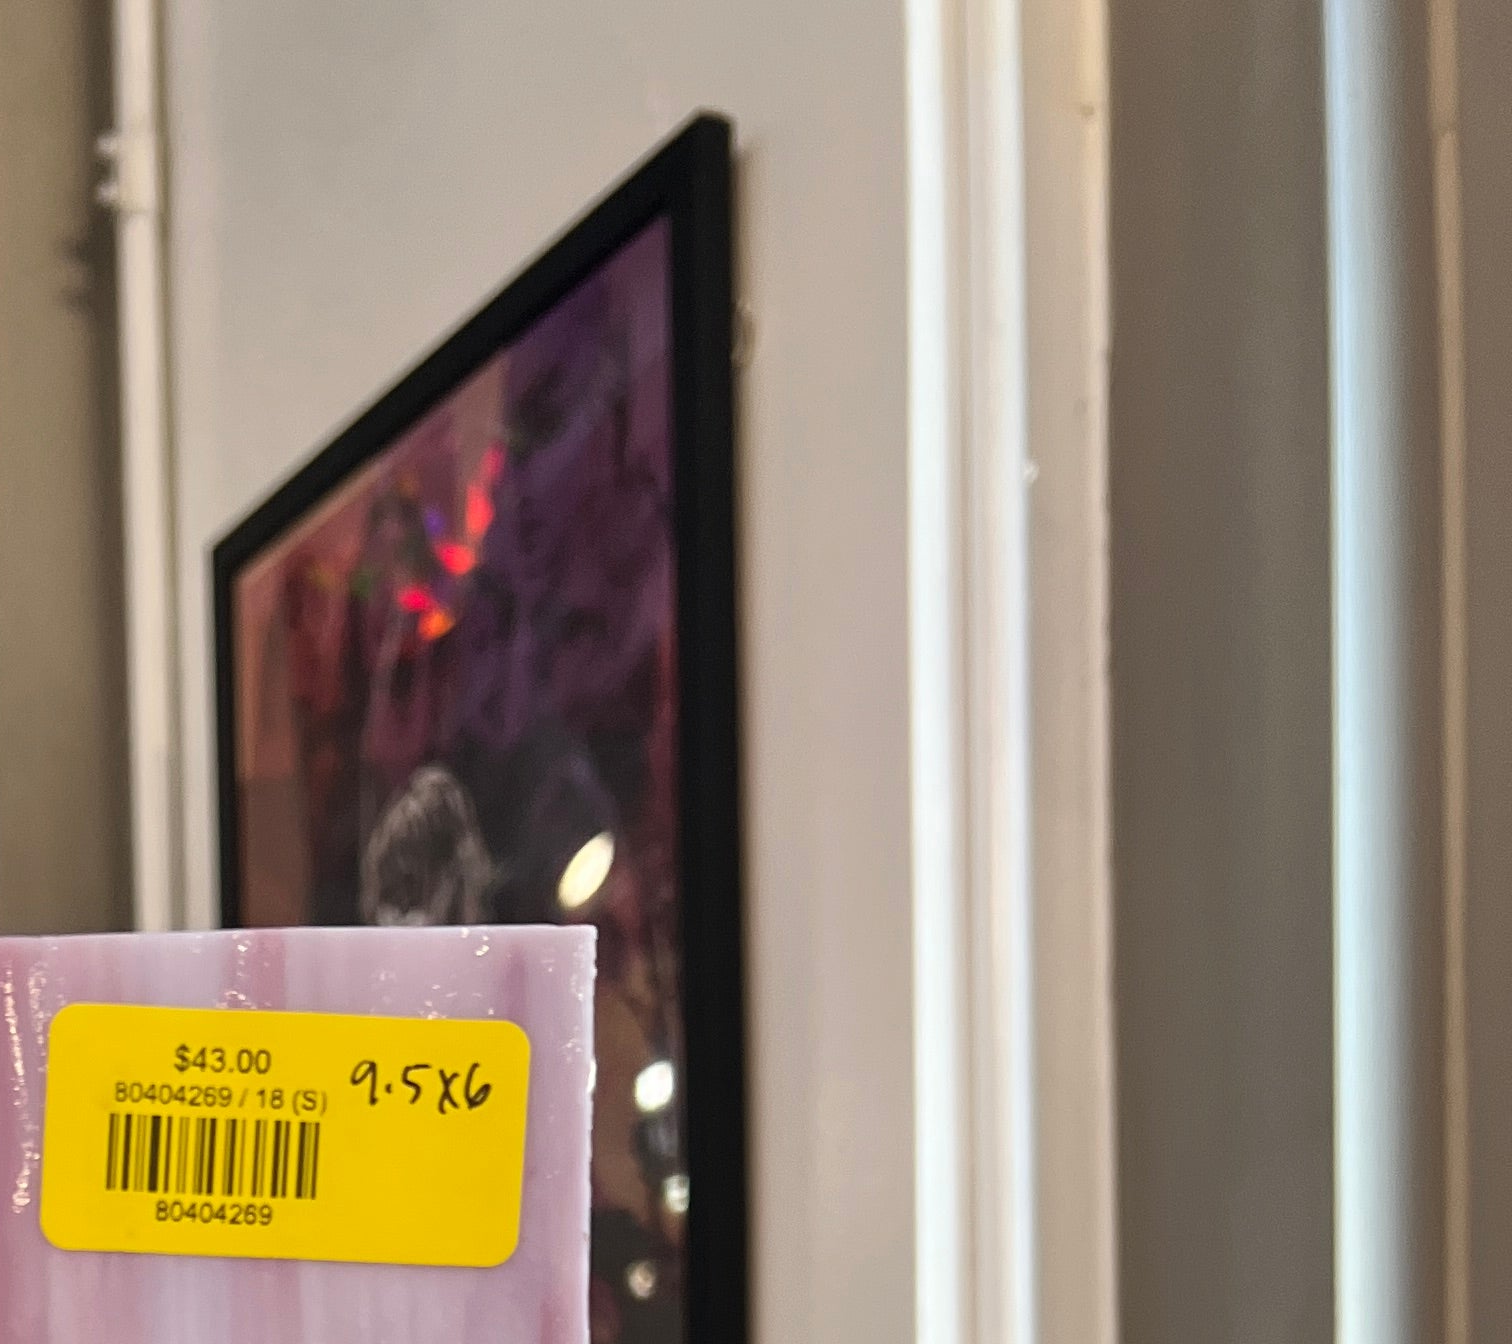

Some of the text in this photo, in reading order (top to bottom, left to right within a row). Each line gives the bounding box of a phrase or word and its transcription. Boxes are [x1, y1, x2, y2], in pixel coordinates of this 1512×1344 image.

[173, 1043, 272, 1075] $43.00
[114, 1081, 328, 1117] 80404269 / 18 (S)
[155, 1199, 274, 1227] 80404269
